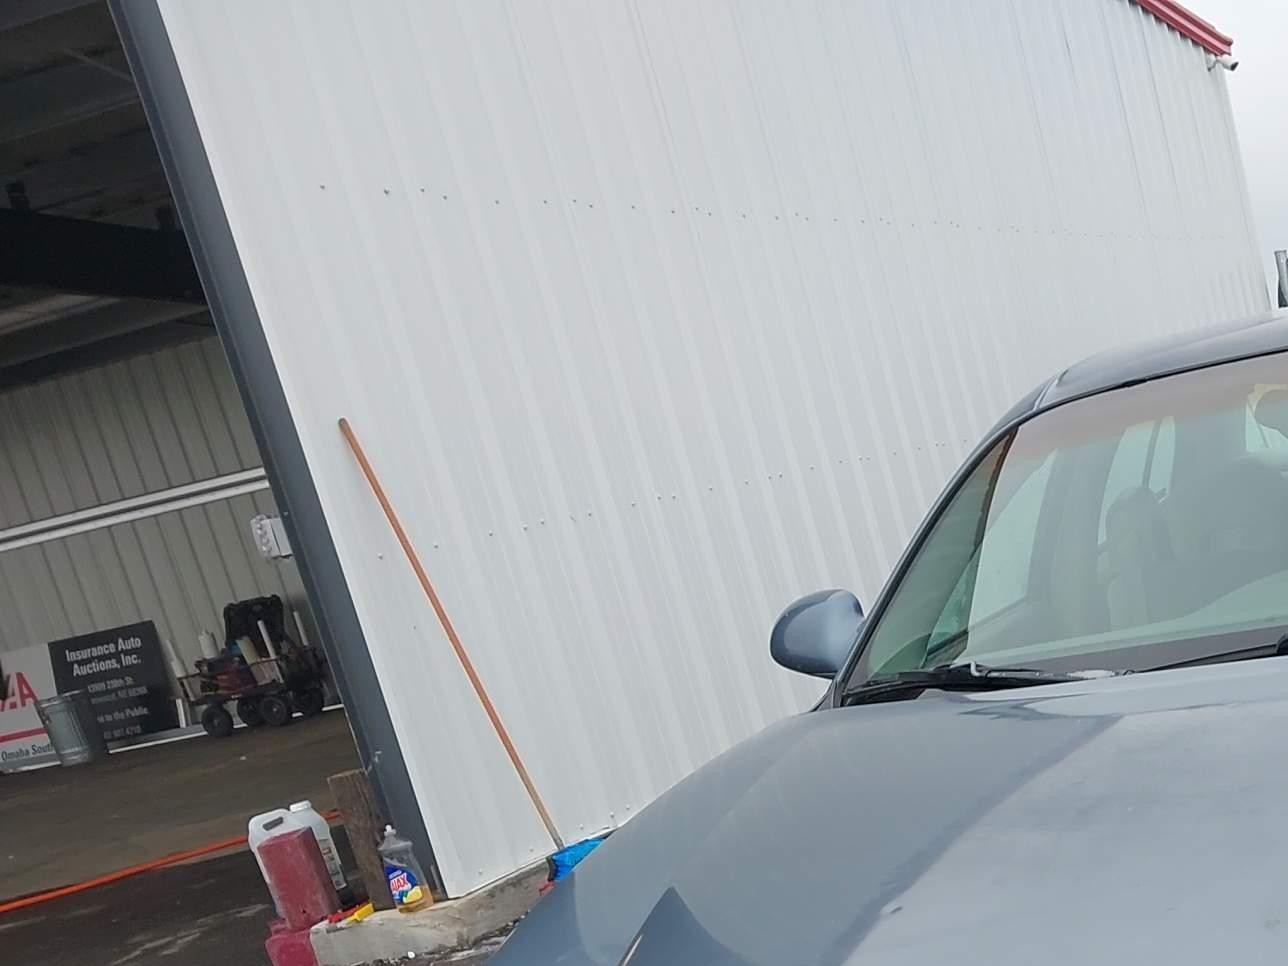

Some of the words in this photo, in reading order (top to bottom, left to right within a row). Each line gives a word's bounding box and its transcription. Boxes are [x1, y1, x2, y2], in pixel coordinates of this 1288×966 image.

[65, 643, 116, 662] Insurance
[118, 637, 141, 651] Auto
[73, 658, 120, 677] Auctions,
[121, 653, 141, 667] Inc.
